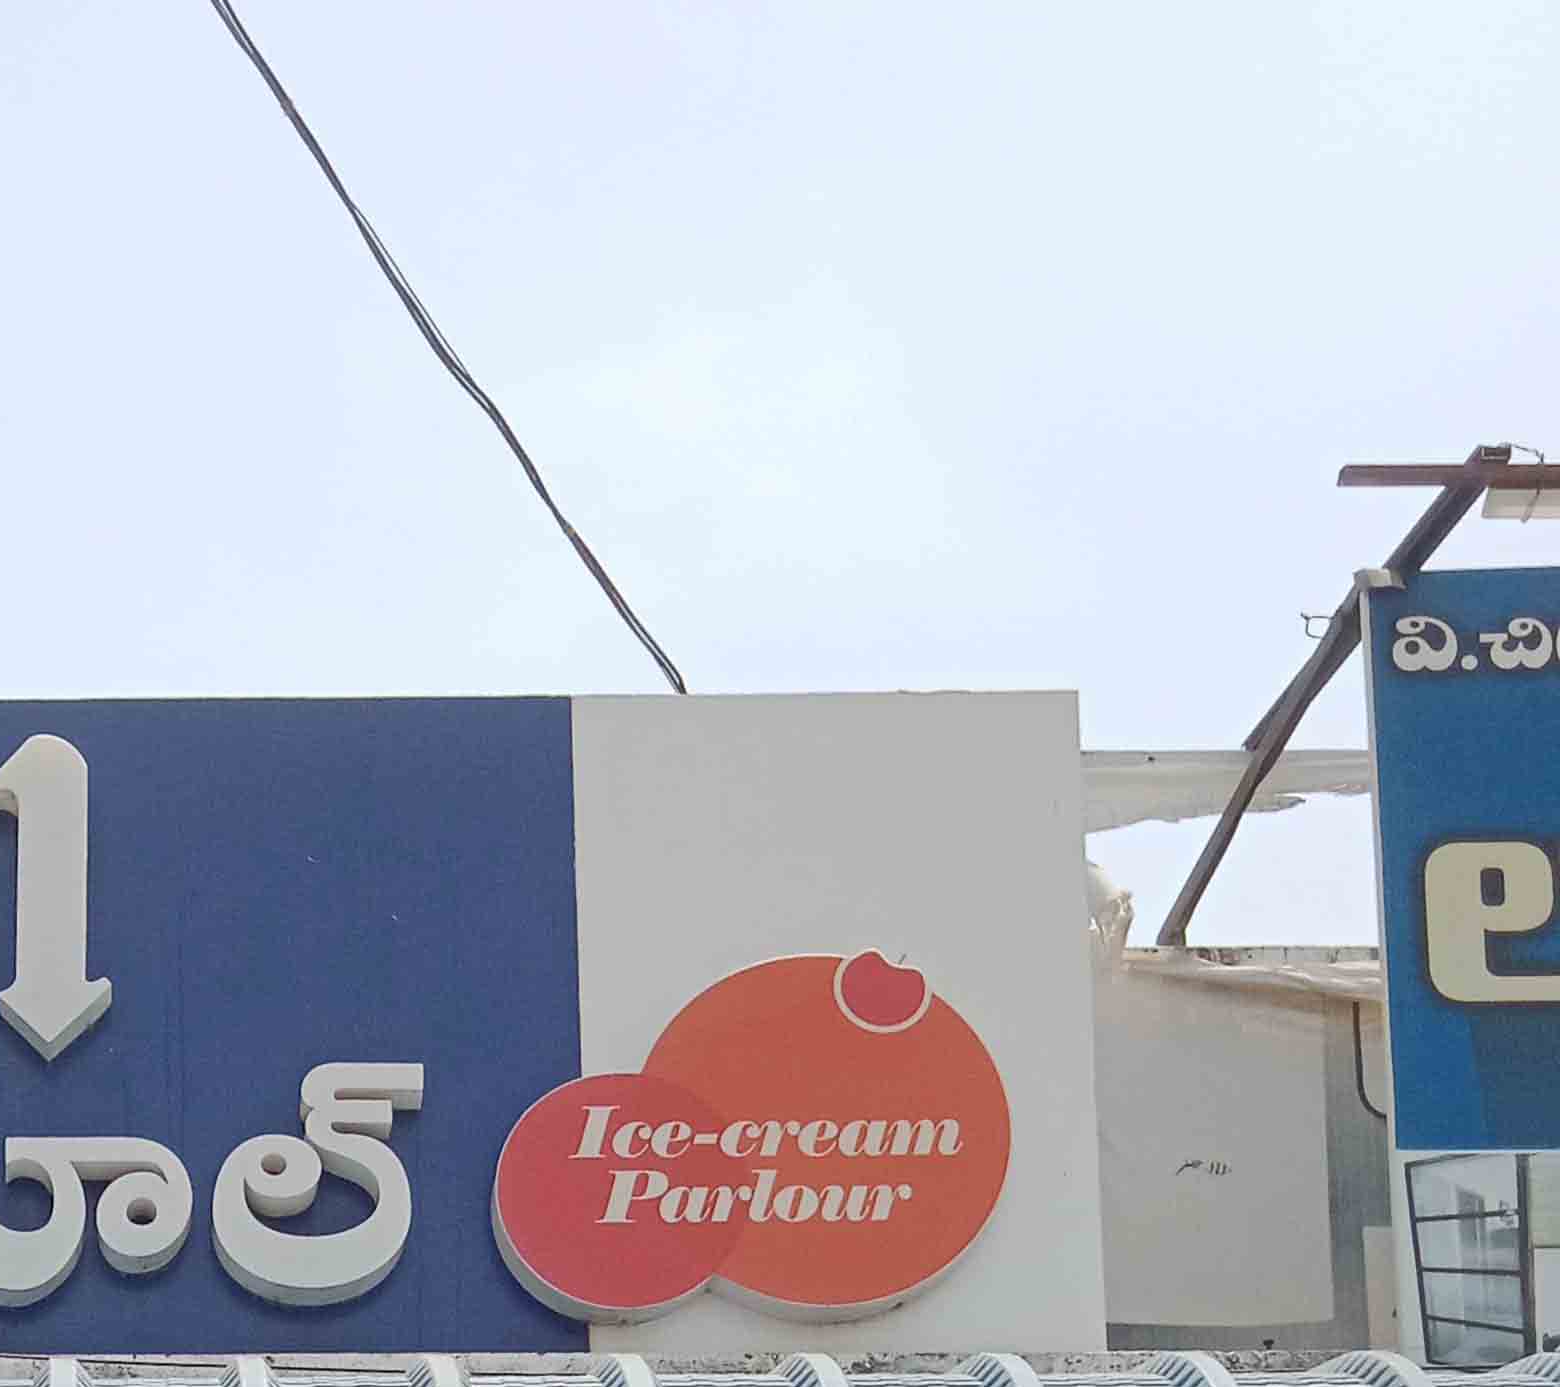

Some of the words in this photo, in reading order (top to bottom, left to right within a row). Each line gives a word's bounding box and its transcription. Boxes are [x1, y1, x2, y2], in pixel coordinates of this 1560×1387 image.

[1392, 616, 1560, 671] వి.చి
[568, 1105, 963, 1159] Ice-cream
[594, 1168, 913, 1224] Parlour
